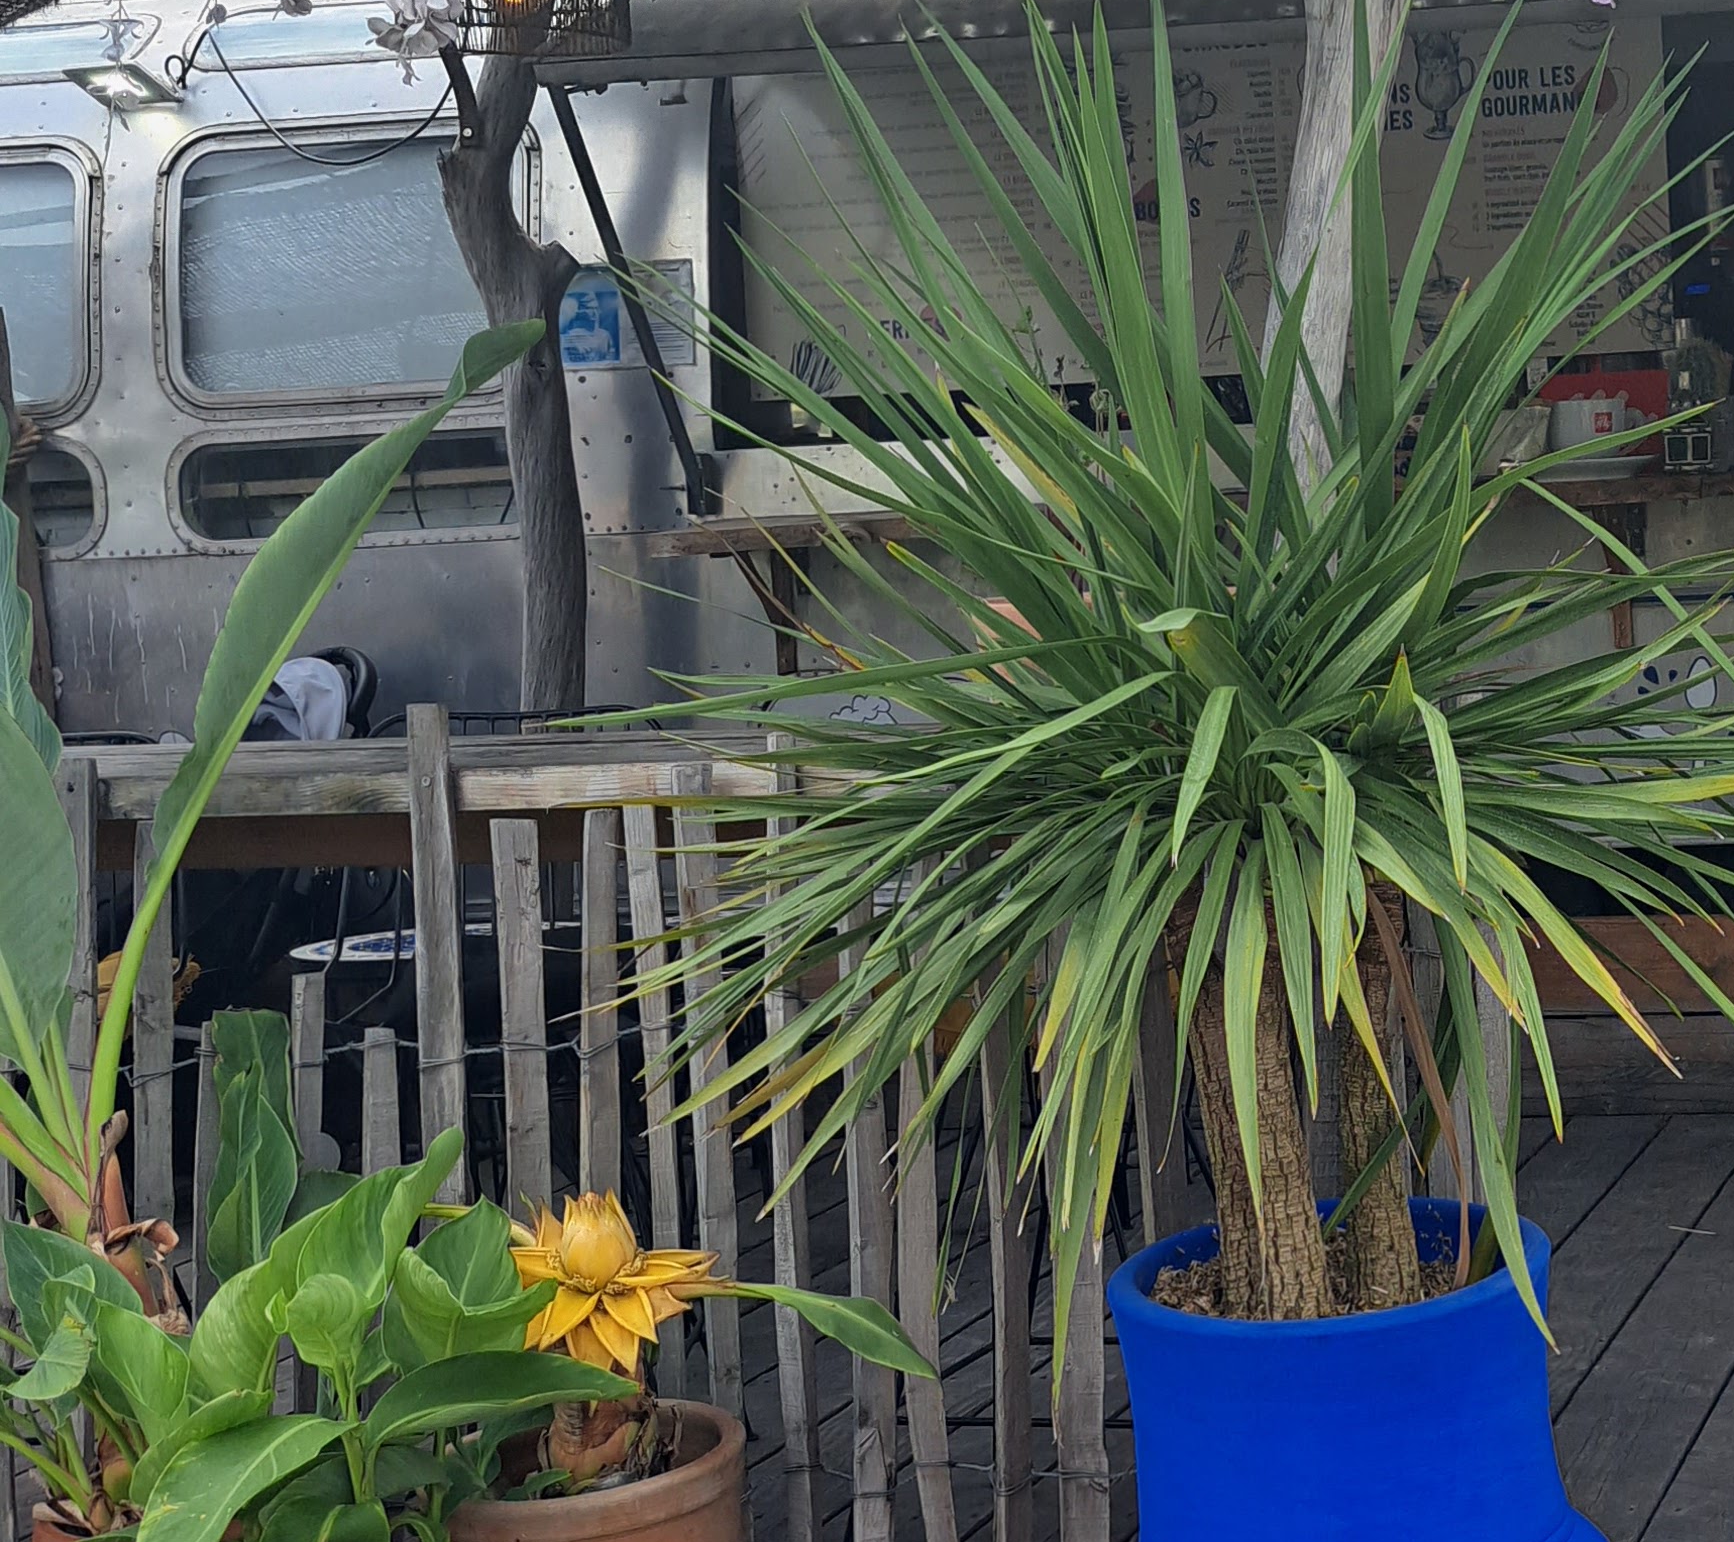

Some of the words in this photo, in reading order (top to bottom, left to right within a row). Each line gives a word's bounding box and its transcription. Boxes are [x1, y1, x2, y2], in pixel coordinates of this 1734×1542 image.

[1540, 65, 1576, 87] LES
[1482, 91, 1598, 118] GOURMAN
[1135, 197, 1201, 221] BOS
